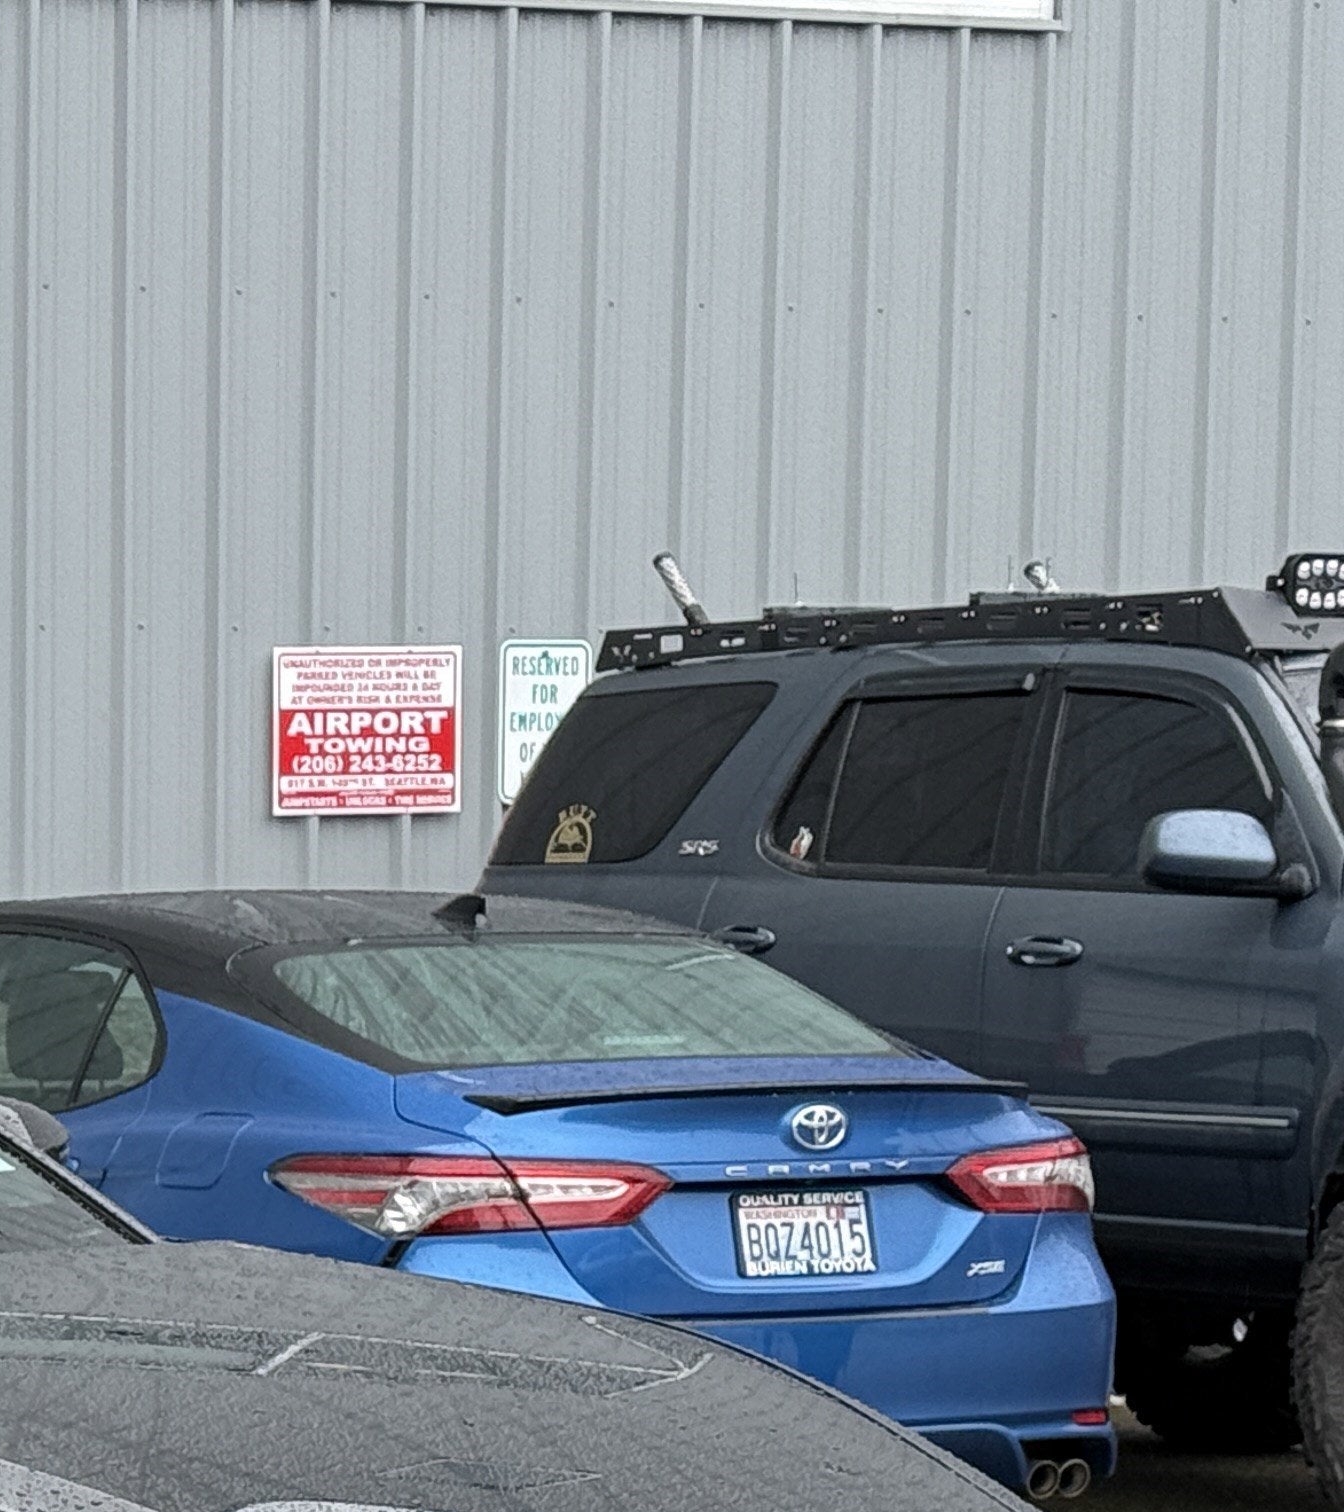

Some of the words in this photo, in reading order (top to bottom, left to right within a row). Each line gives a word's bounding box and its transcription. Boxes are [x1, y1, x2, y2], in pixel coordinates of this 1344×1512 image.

[512, 656, 579, 676] RESERVED
[532, 684, 558, 704] FOR
[287, 711, 449, 737] AIRPORT
[304, 737, 431, 754] TOWING
[292, 755, 344, 773] (206)
[349, 754, 443, 773] 243-6252
[725, 1159, 909, 1178] CAMRY
[739, 1193, 797, 1207] QUALITY
[803, 1190, 864, 1205] SERVICE
[744, 1208, 818, 1221] WASHINGTON
[747, 1219, 867, 1262] BQZ4015
[747, 1259, 808, 1276] BURIEN
[811, 1256, 877, 1273] TOYOTA
